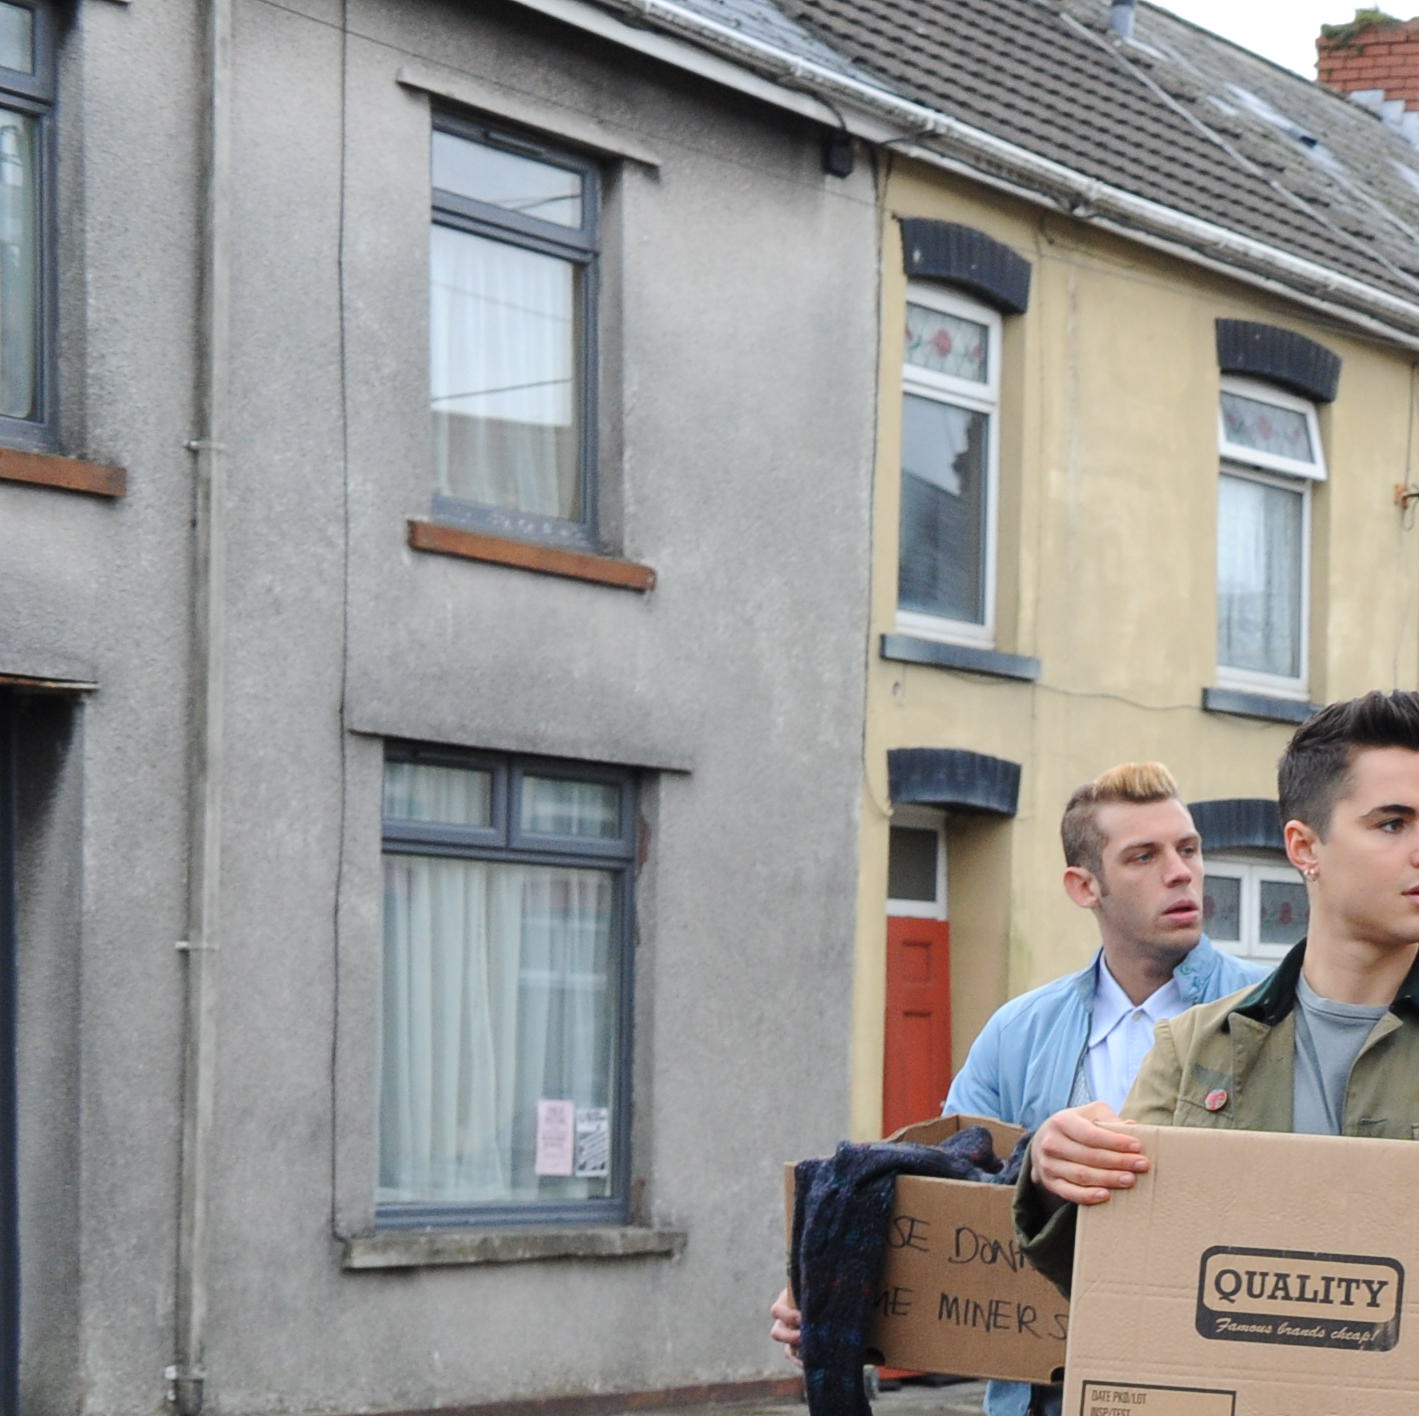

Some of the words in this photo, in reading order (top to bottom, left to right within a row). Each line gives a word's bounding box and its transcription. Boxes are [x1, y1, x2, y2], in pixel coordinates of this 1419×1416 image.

[1214, 1268, 1389, 1308] QUALITY
[938, 1292, 1069, 1340] MINERS
[1215, 1317, 1272, 1334] Famous
[1276, 1321, 1326, 1338] brands
[1330, 1326, 1382, 1344] cheap!
[1091, 1390, 1112, 1403] DATE
